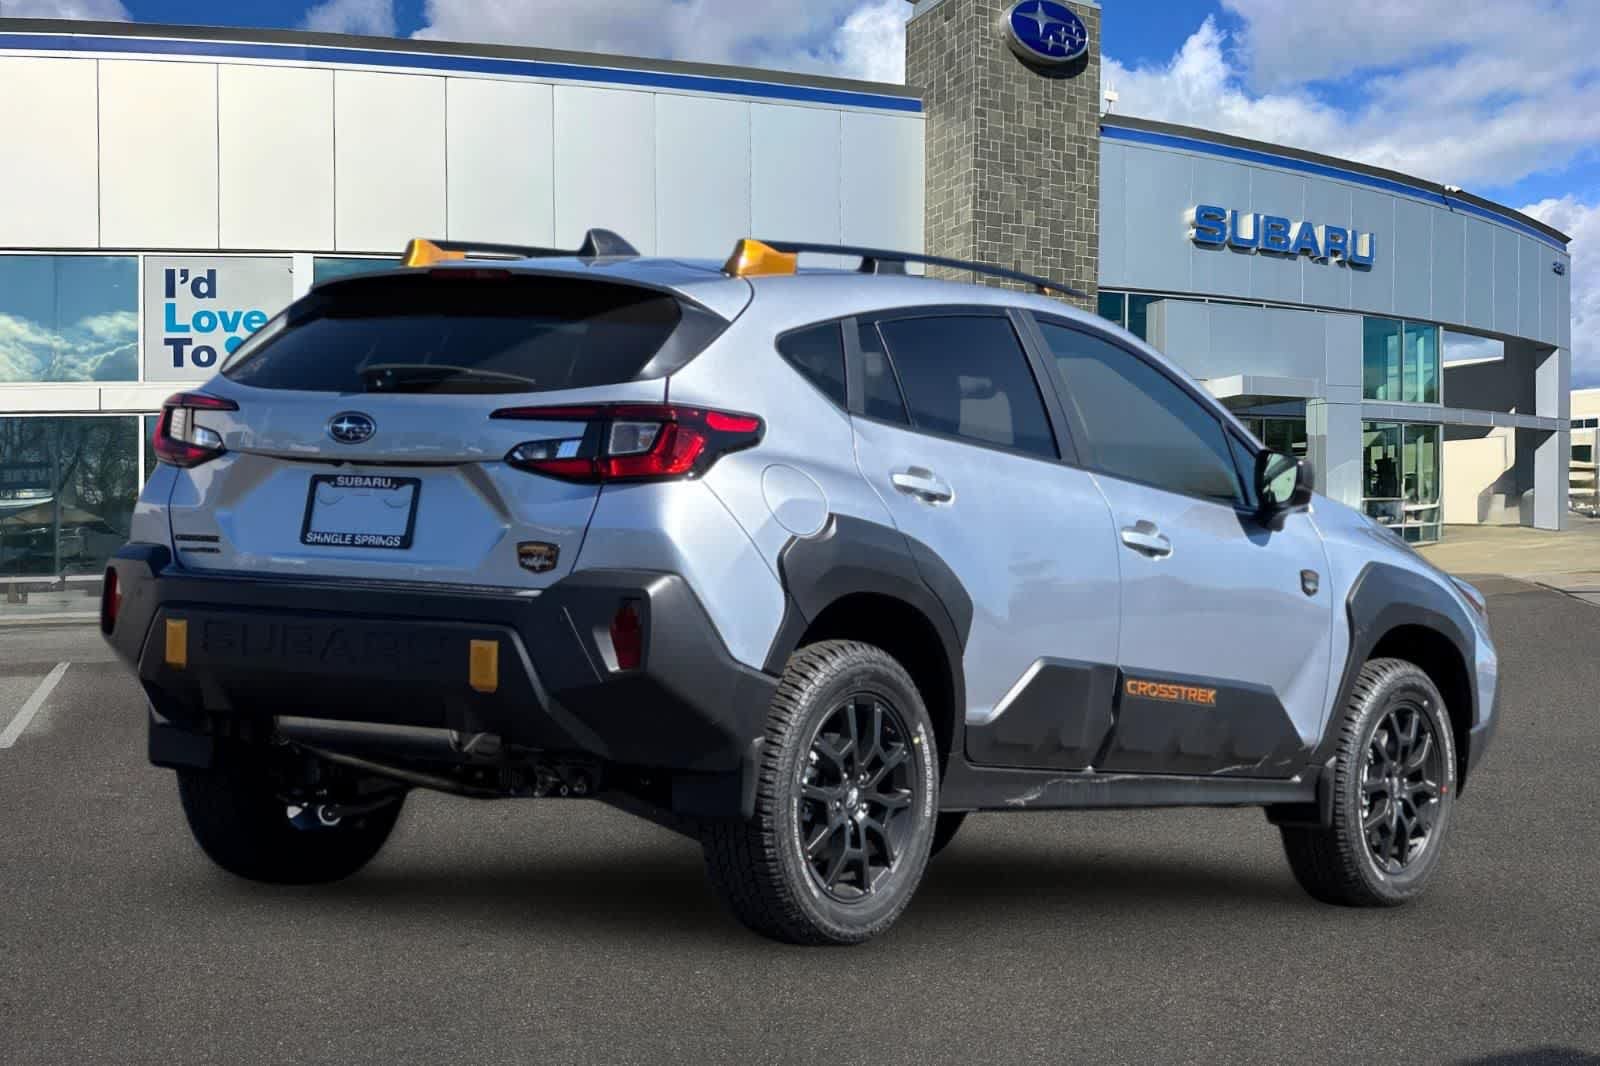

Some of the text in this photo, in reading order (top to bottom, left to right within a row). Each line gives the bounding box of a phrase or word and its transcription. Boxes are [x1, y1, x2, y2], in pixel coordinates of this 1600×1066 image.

[1191, 204, 1376, 269] SUBARU
[165, 268, 217, 299] I'd
[165, 303, 268, 333] Love
[164, 337, 217, 368] To
[336, 476, 392, 488] SUBARU
[306, 532, 401, 547] SHINGLE SPRINGS
[1126, 680, 1217, 703] CROSSTREK
